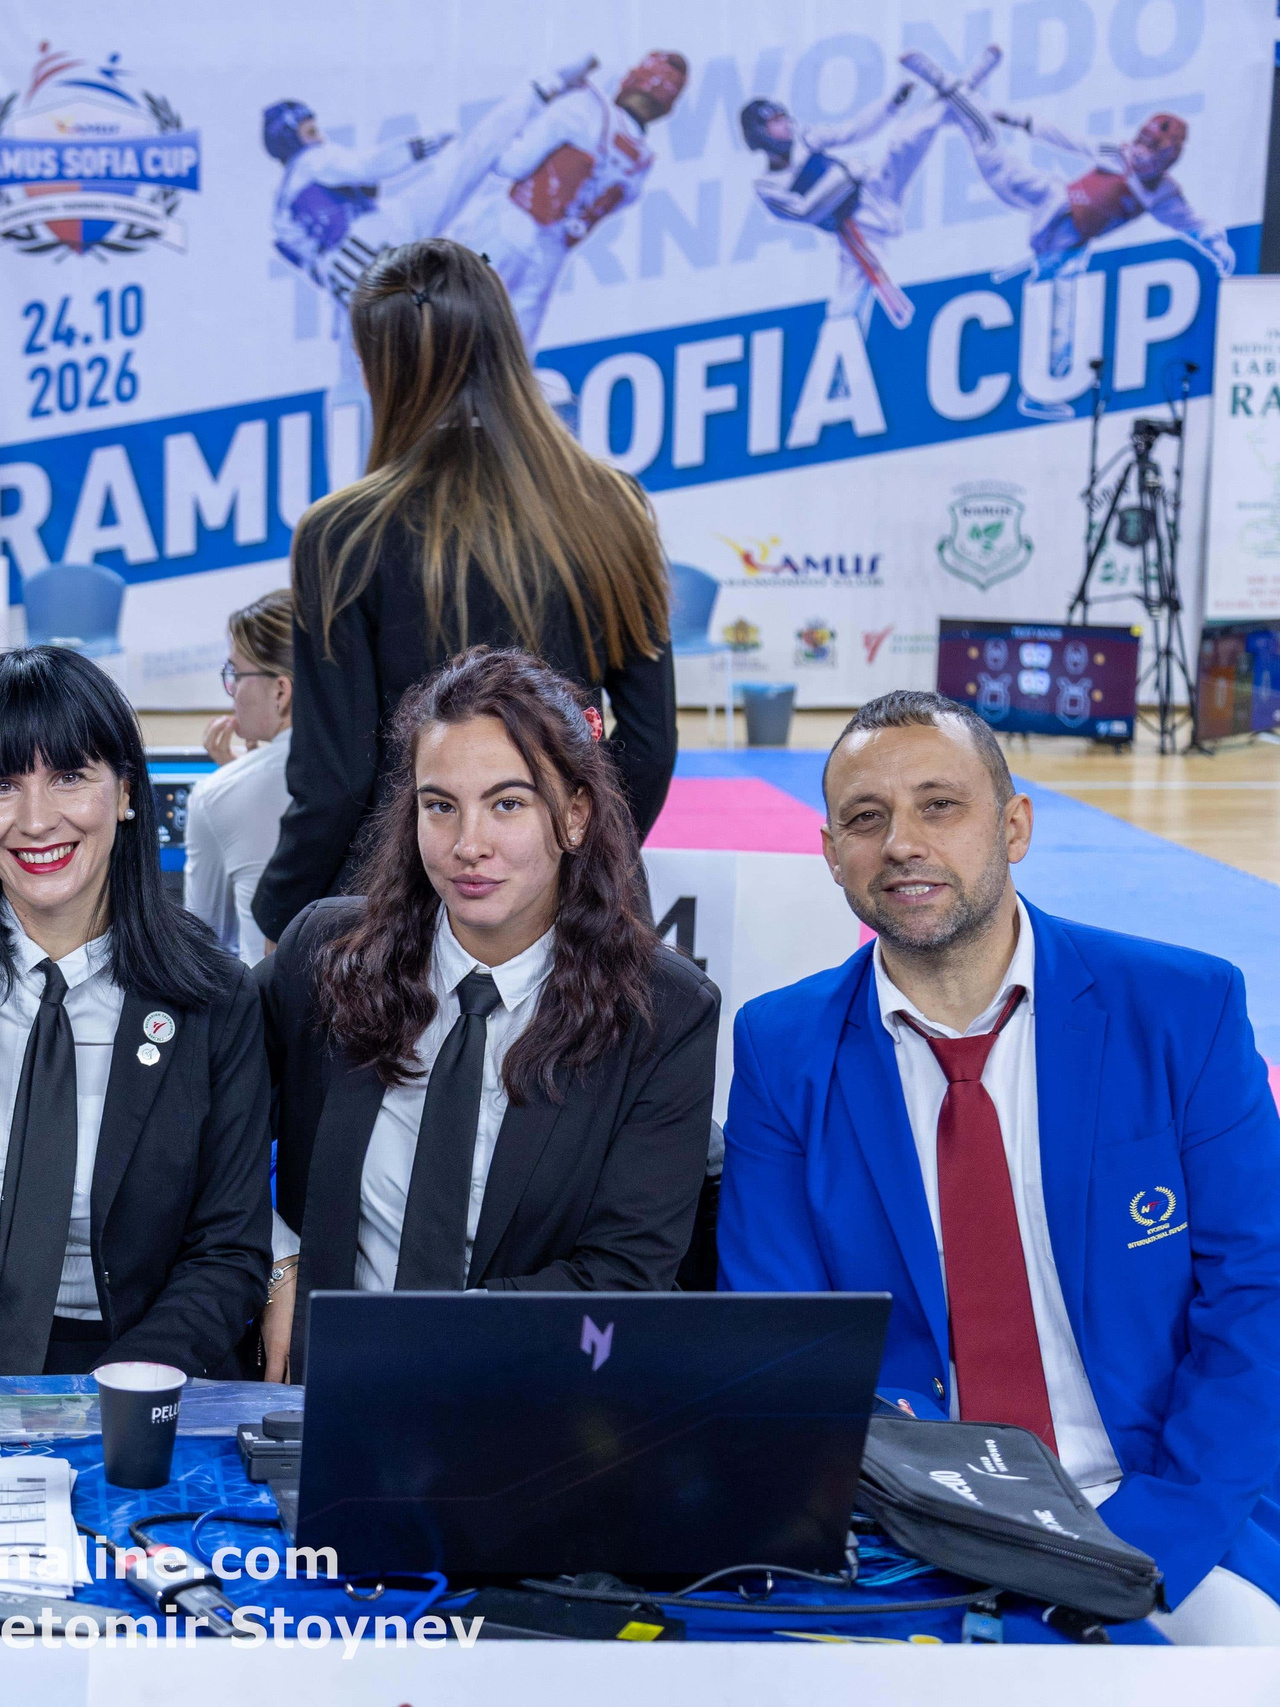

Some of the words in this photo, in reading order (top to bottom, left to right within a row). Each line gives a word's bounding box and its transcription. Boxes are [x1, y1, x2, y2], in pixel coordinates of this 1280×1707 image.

[62, 147, 139, 178] SOFIA
[143, 146, 197, 178] CUP
[23, 284, 144, 356] 24.10
[29, 351, 139, 419] 2026
[534, 315, 887, 478] OFIA
[926, 257, 1201, 422] CUP
